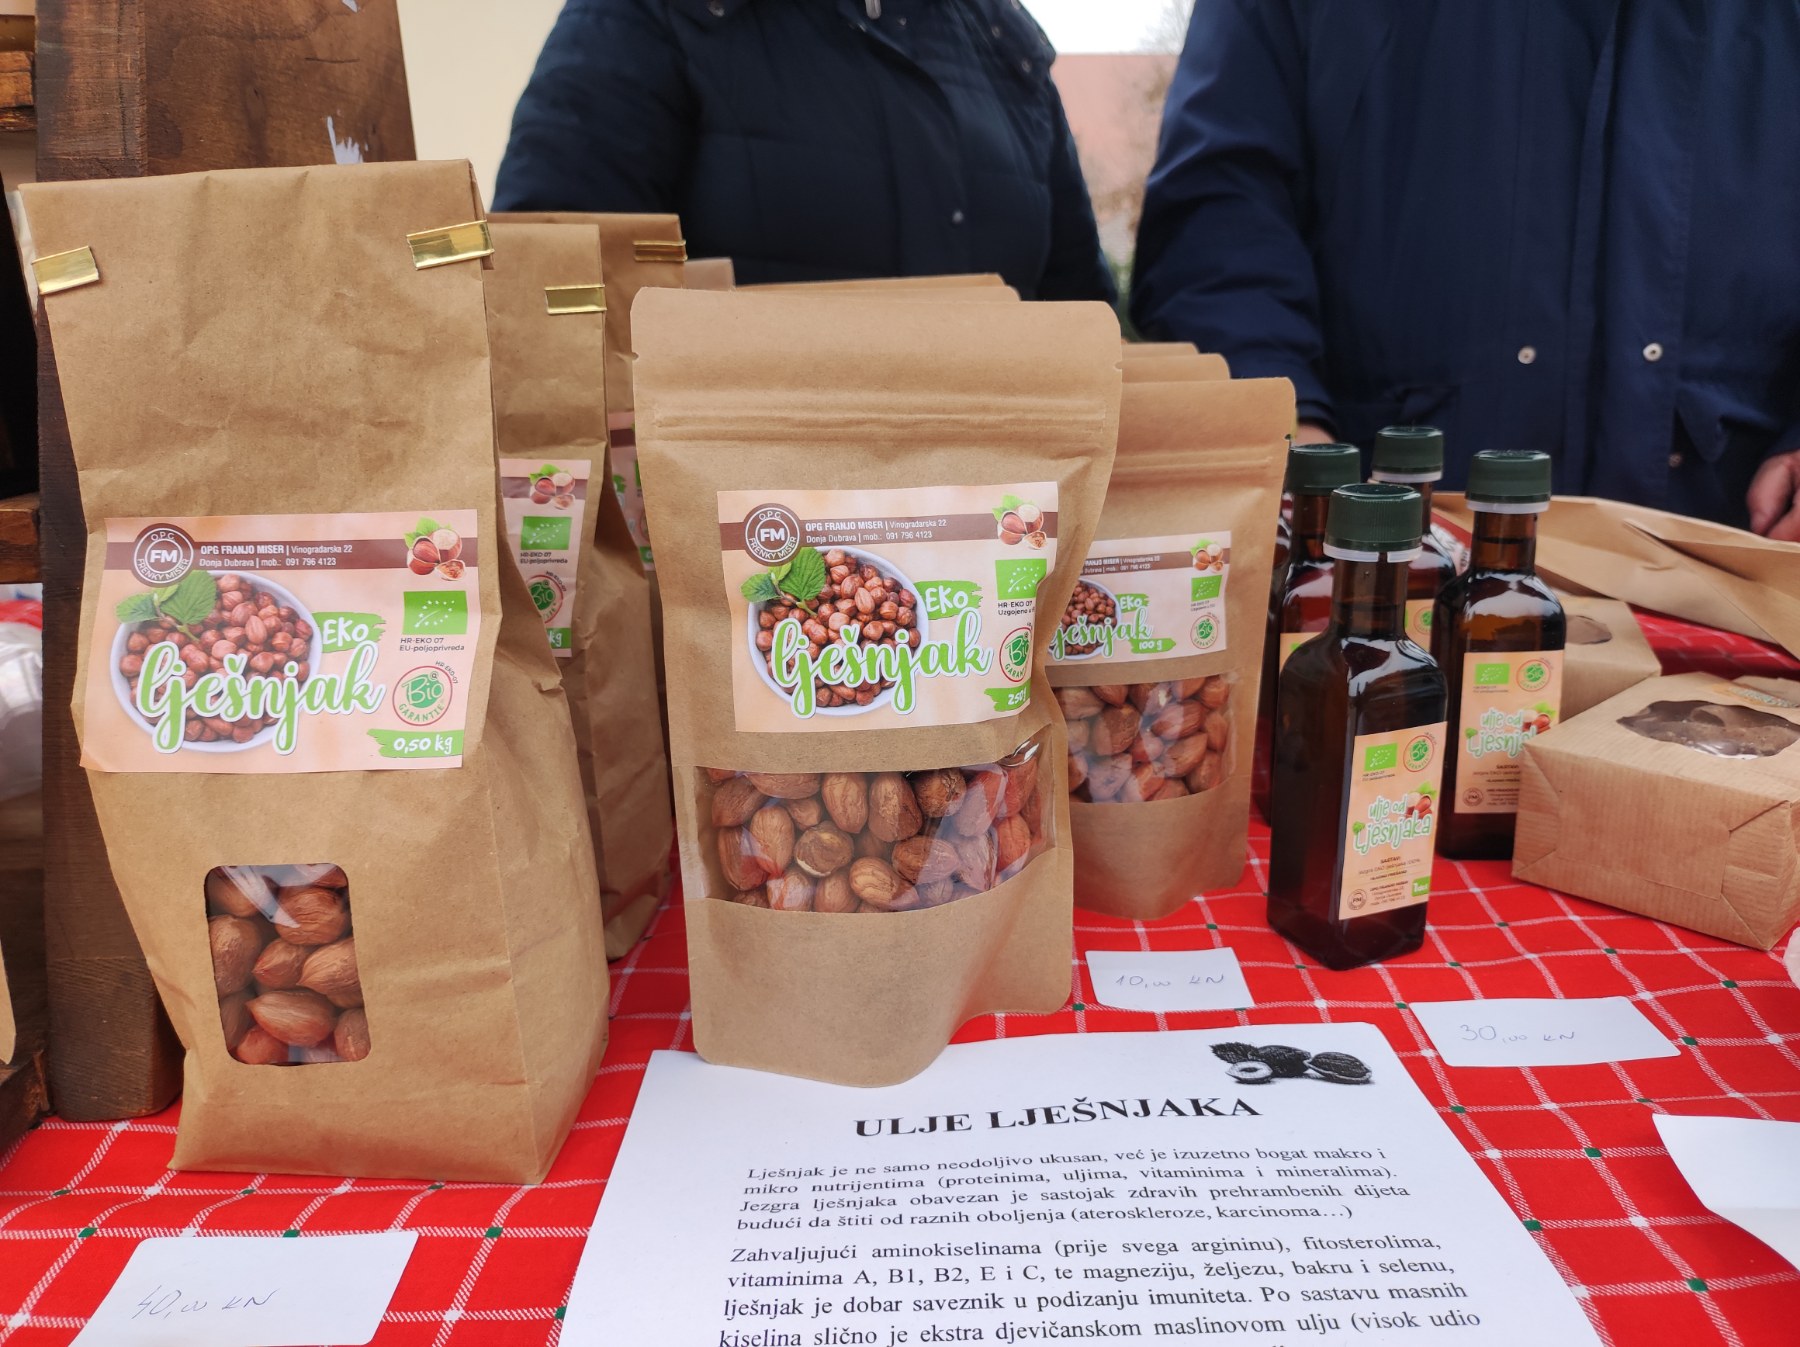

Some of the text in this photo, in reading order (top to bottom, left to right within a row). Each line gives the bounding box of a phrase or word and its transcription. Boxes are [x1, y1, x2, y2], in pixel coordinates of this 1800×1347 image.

[760, 528, 785, 542] FM
[805, 519, 947, 532] OPG FRANJO MISER Vinogradarska 22
[806, 534, 827, 545] Donja
[828, 533, 857, 542] Dubrava
[885, 531, 899, 540] 091
[900, 531, 914, 540] 796
[915, 530, 933, 539] 4123
[150, 549, 178, 563] FM
[200, 544, 353, 555] OPG FRANJO MISER Vinogradarska 22
[749, 536, 797, 560] FRENKY MISER
[137, 558, 189, 580] FRENKY MISER
[199, 558, 222, 568] Donja
[224, 558, 255, 567] Dubrava
[285, 557, 299, 566] 091
[302, 557, 316, 566] 796
[317, 557, 337, 566] 4123
[926, 587, 969, 612] EKO
[1120, 596, 1143, 610] EKO
[322, 617, 370, 645] EKO
[1050, 607, 1153, 661] ješnjak
[399, 644, 465, 653] EU-poljoprivreda
[772, 607, 994, 719] lješnjak
[138, 641, 386, 754] lješnjak
[401, 676, 445, 704] Bio
[399, 703, 445, 722] GARANTIE
[434, 734, 453, 755] kg
[1369, 794, 1408, 822] ulje od
[854, 1097, 1264, 1137] ULJE LJEŠNJAKA
[747, 1147, 1387, 1181] Lješnjak je ne samo neodoljivo ukusan, već je izuzetno bogat makro i
[743, 1165, 1398, 1195] mikro nutrijentima (proteinima, uljima, vitaminima i mineralima).
[739, 1184, 1411, 1214] Jezgra lješnjaka obavezan je sastojak zdravih prehrambenih dijeta
[737, 1216, 802, 1231] budući
[807, 1216, 832, 1228] da
[837, 1214, 873, 1227] štiti
[880, 1213, 904, 1226] od
[910, 1210, 971, 1225] raznih
[976, 1206, 1066, 1224] oboljenja
[1070, 1205, 1213, 1224] (ateroskleroze,
[729, 1234, 1442, 1264] Zahvaljujući aminokiselinama (prije svega argininu), fitosterolima,
[727, 1258, 1455, 1288] vitaminima A, B1, B2, E i C, te magneziju, željezu, bakru i selenu,
[723, 1282, 1469, 1322] lješnjak je dobar saveznik u podizanju imuniteta. Po sastavu masnih
[718, 1309, 1481, 1347] kiselina slično je ekstra djevičanskom maslinovom ulju (visok udio
